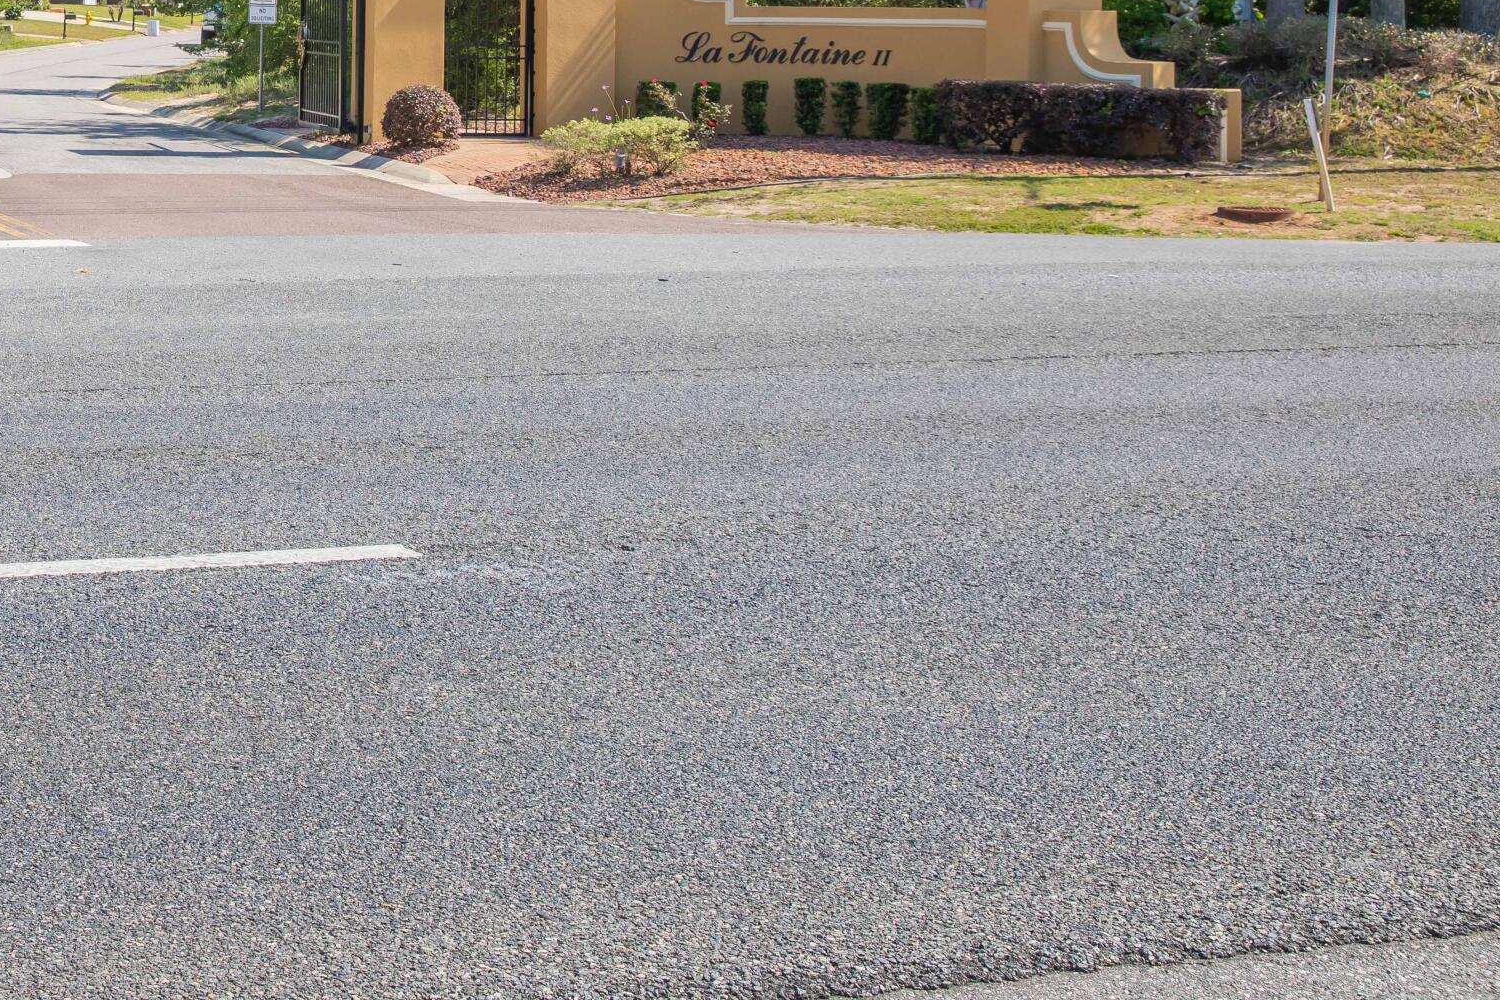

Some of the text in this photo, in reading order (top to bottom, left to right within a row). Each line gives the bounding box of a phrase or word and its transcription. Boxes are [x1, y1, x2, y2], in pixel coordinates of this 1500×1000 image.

[674, 31, 892, 66] La Fontaine II
